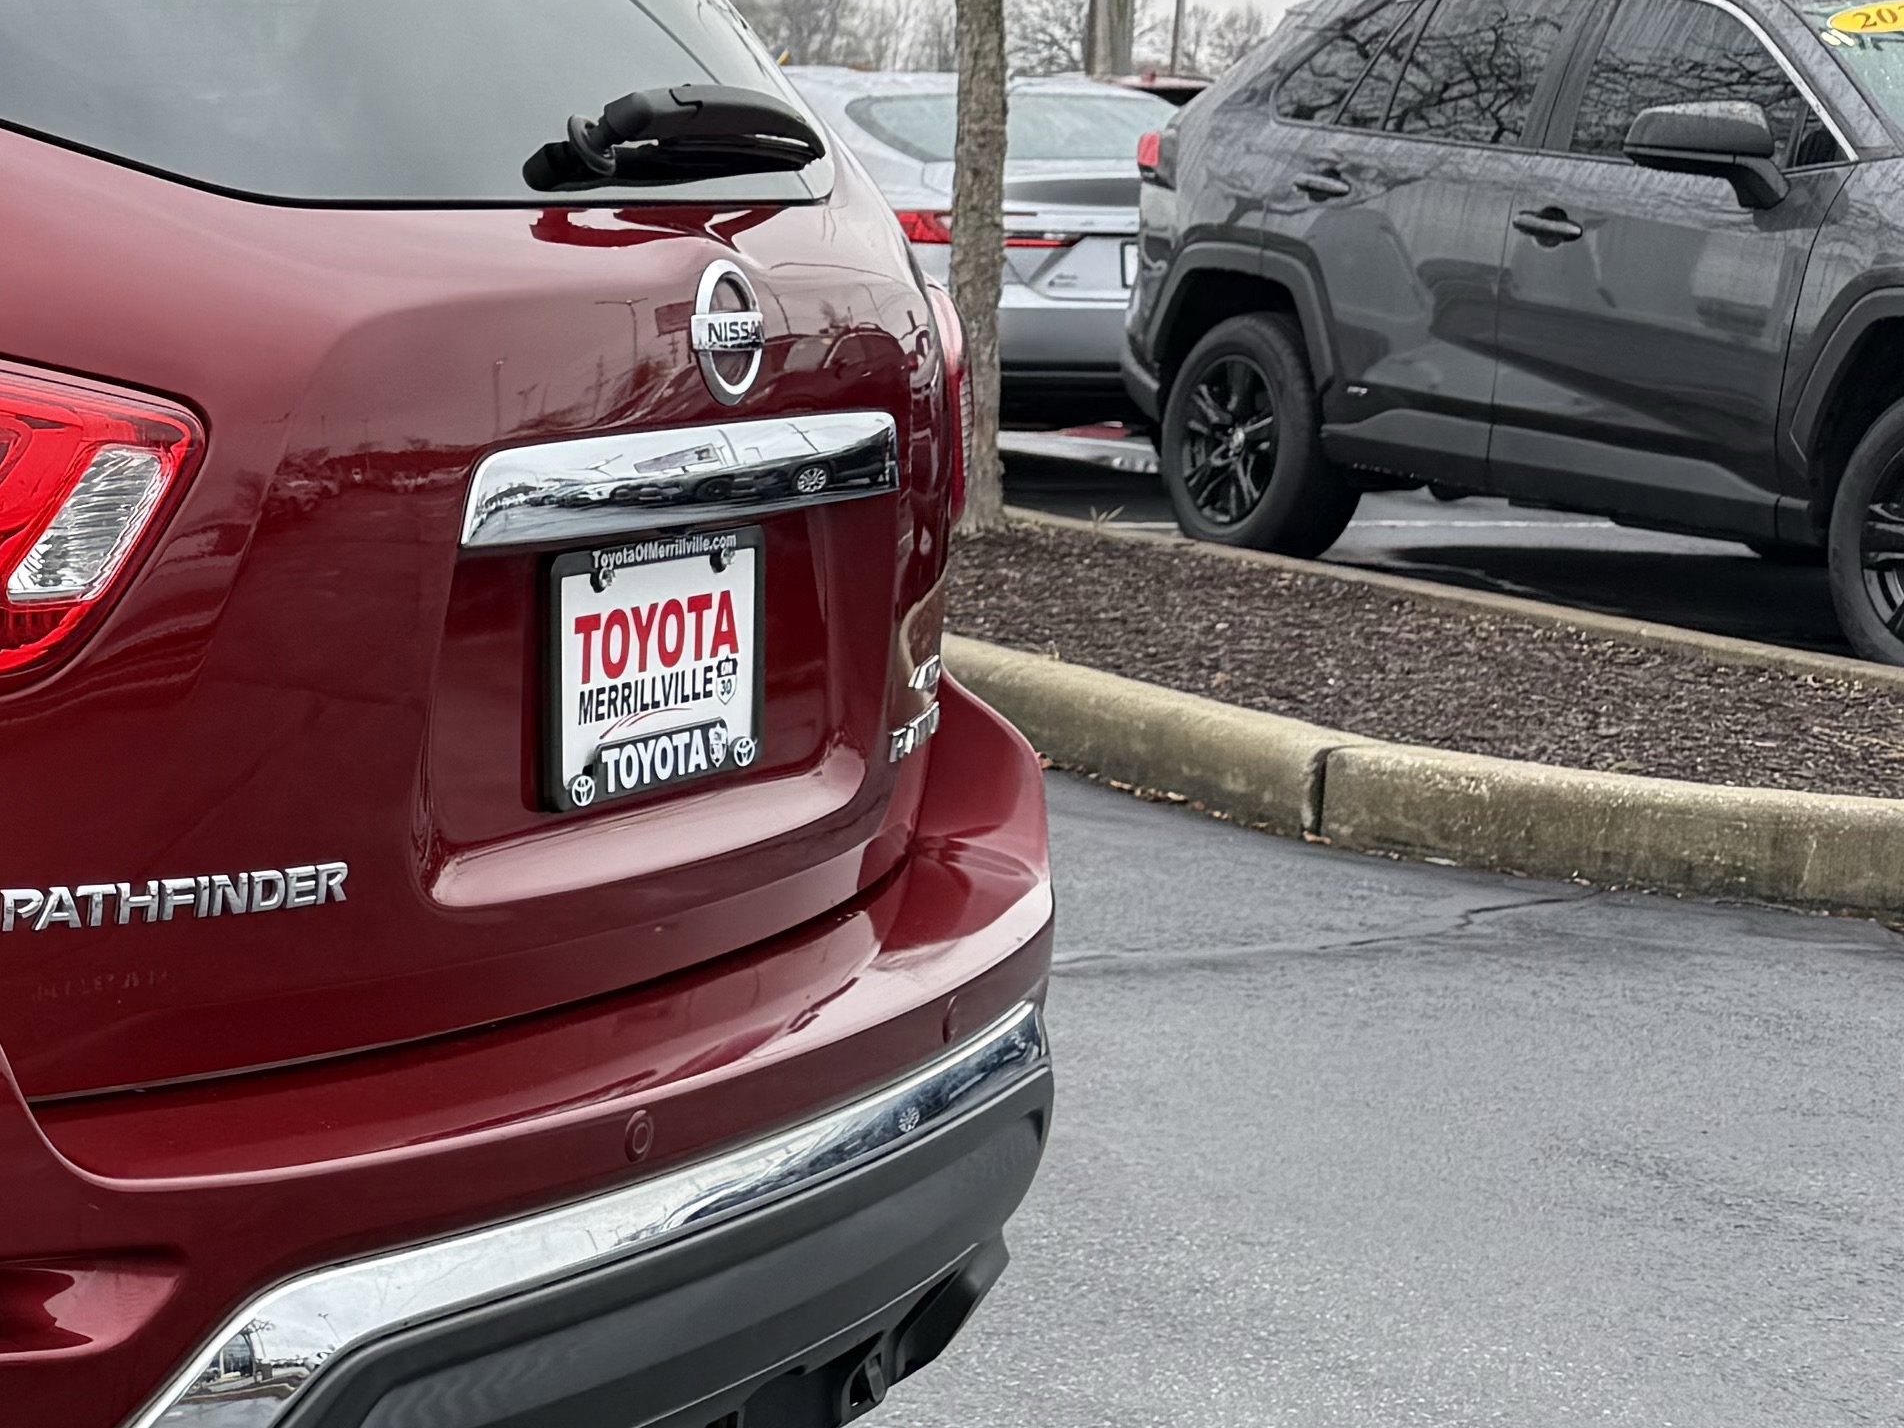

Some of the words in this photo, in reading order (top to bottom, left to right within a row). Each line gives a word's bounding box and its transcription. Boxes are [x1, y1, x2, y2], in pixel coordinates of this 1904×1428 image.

[592, 533, 736, 569] ToyotaOfMerrillville.com
[574, 590, 739, 685] TOYOTA
[578, 665, 714, 726] MERRILLVILLE
[601, 728, 708, 794] TOYOTA
[0, 861, 349, 932] PATHFINDER
